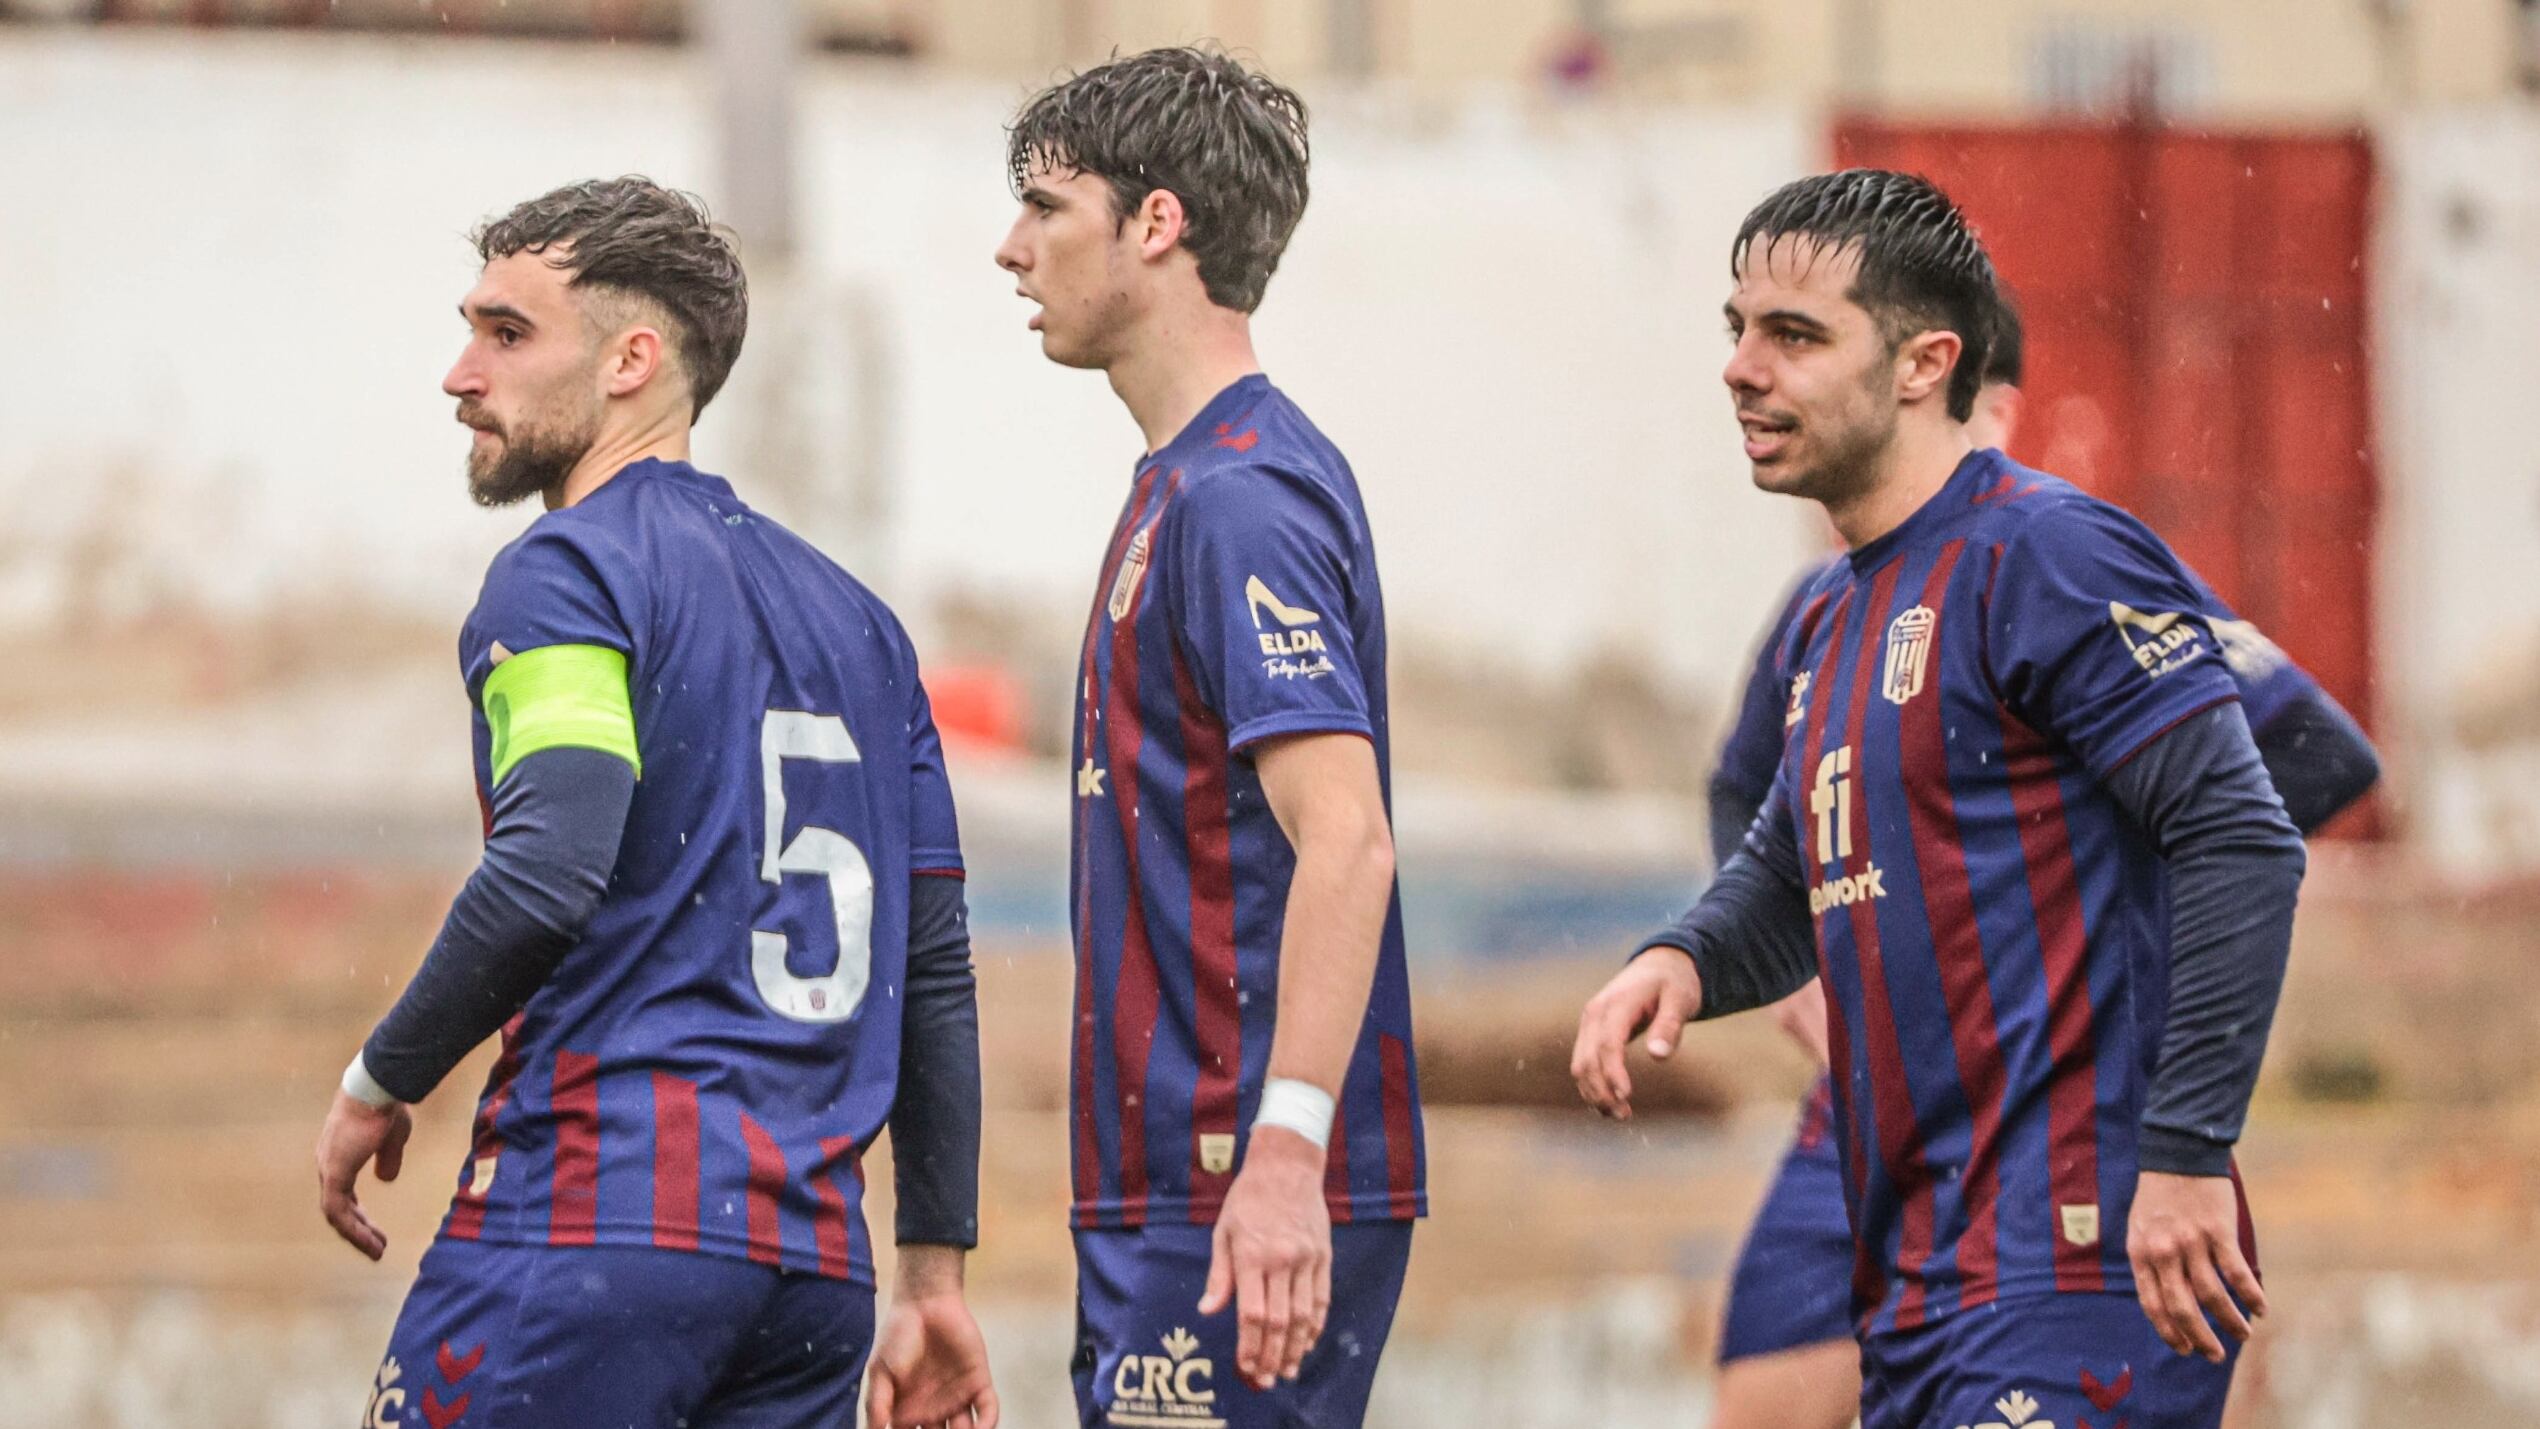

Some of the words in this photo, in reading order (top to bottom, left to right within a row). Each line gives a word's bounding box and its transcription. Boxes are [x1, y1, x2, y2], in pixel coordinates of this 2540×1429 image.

[1258, 630, 1327, 656] ELDA
[2132, 622, 2198, 669] ELDA
[1810, 745, 1853, 865] fi
[752, 708, 874, 1023] 5
[1114, 1354, 1216, 1404] CRC
